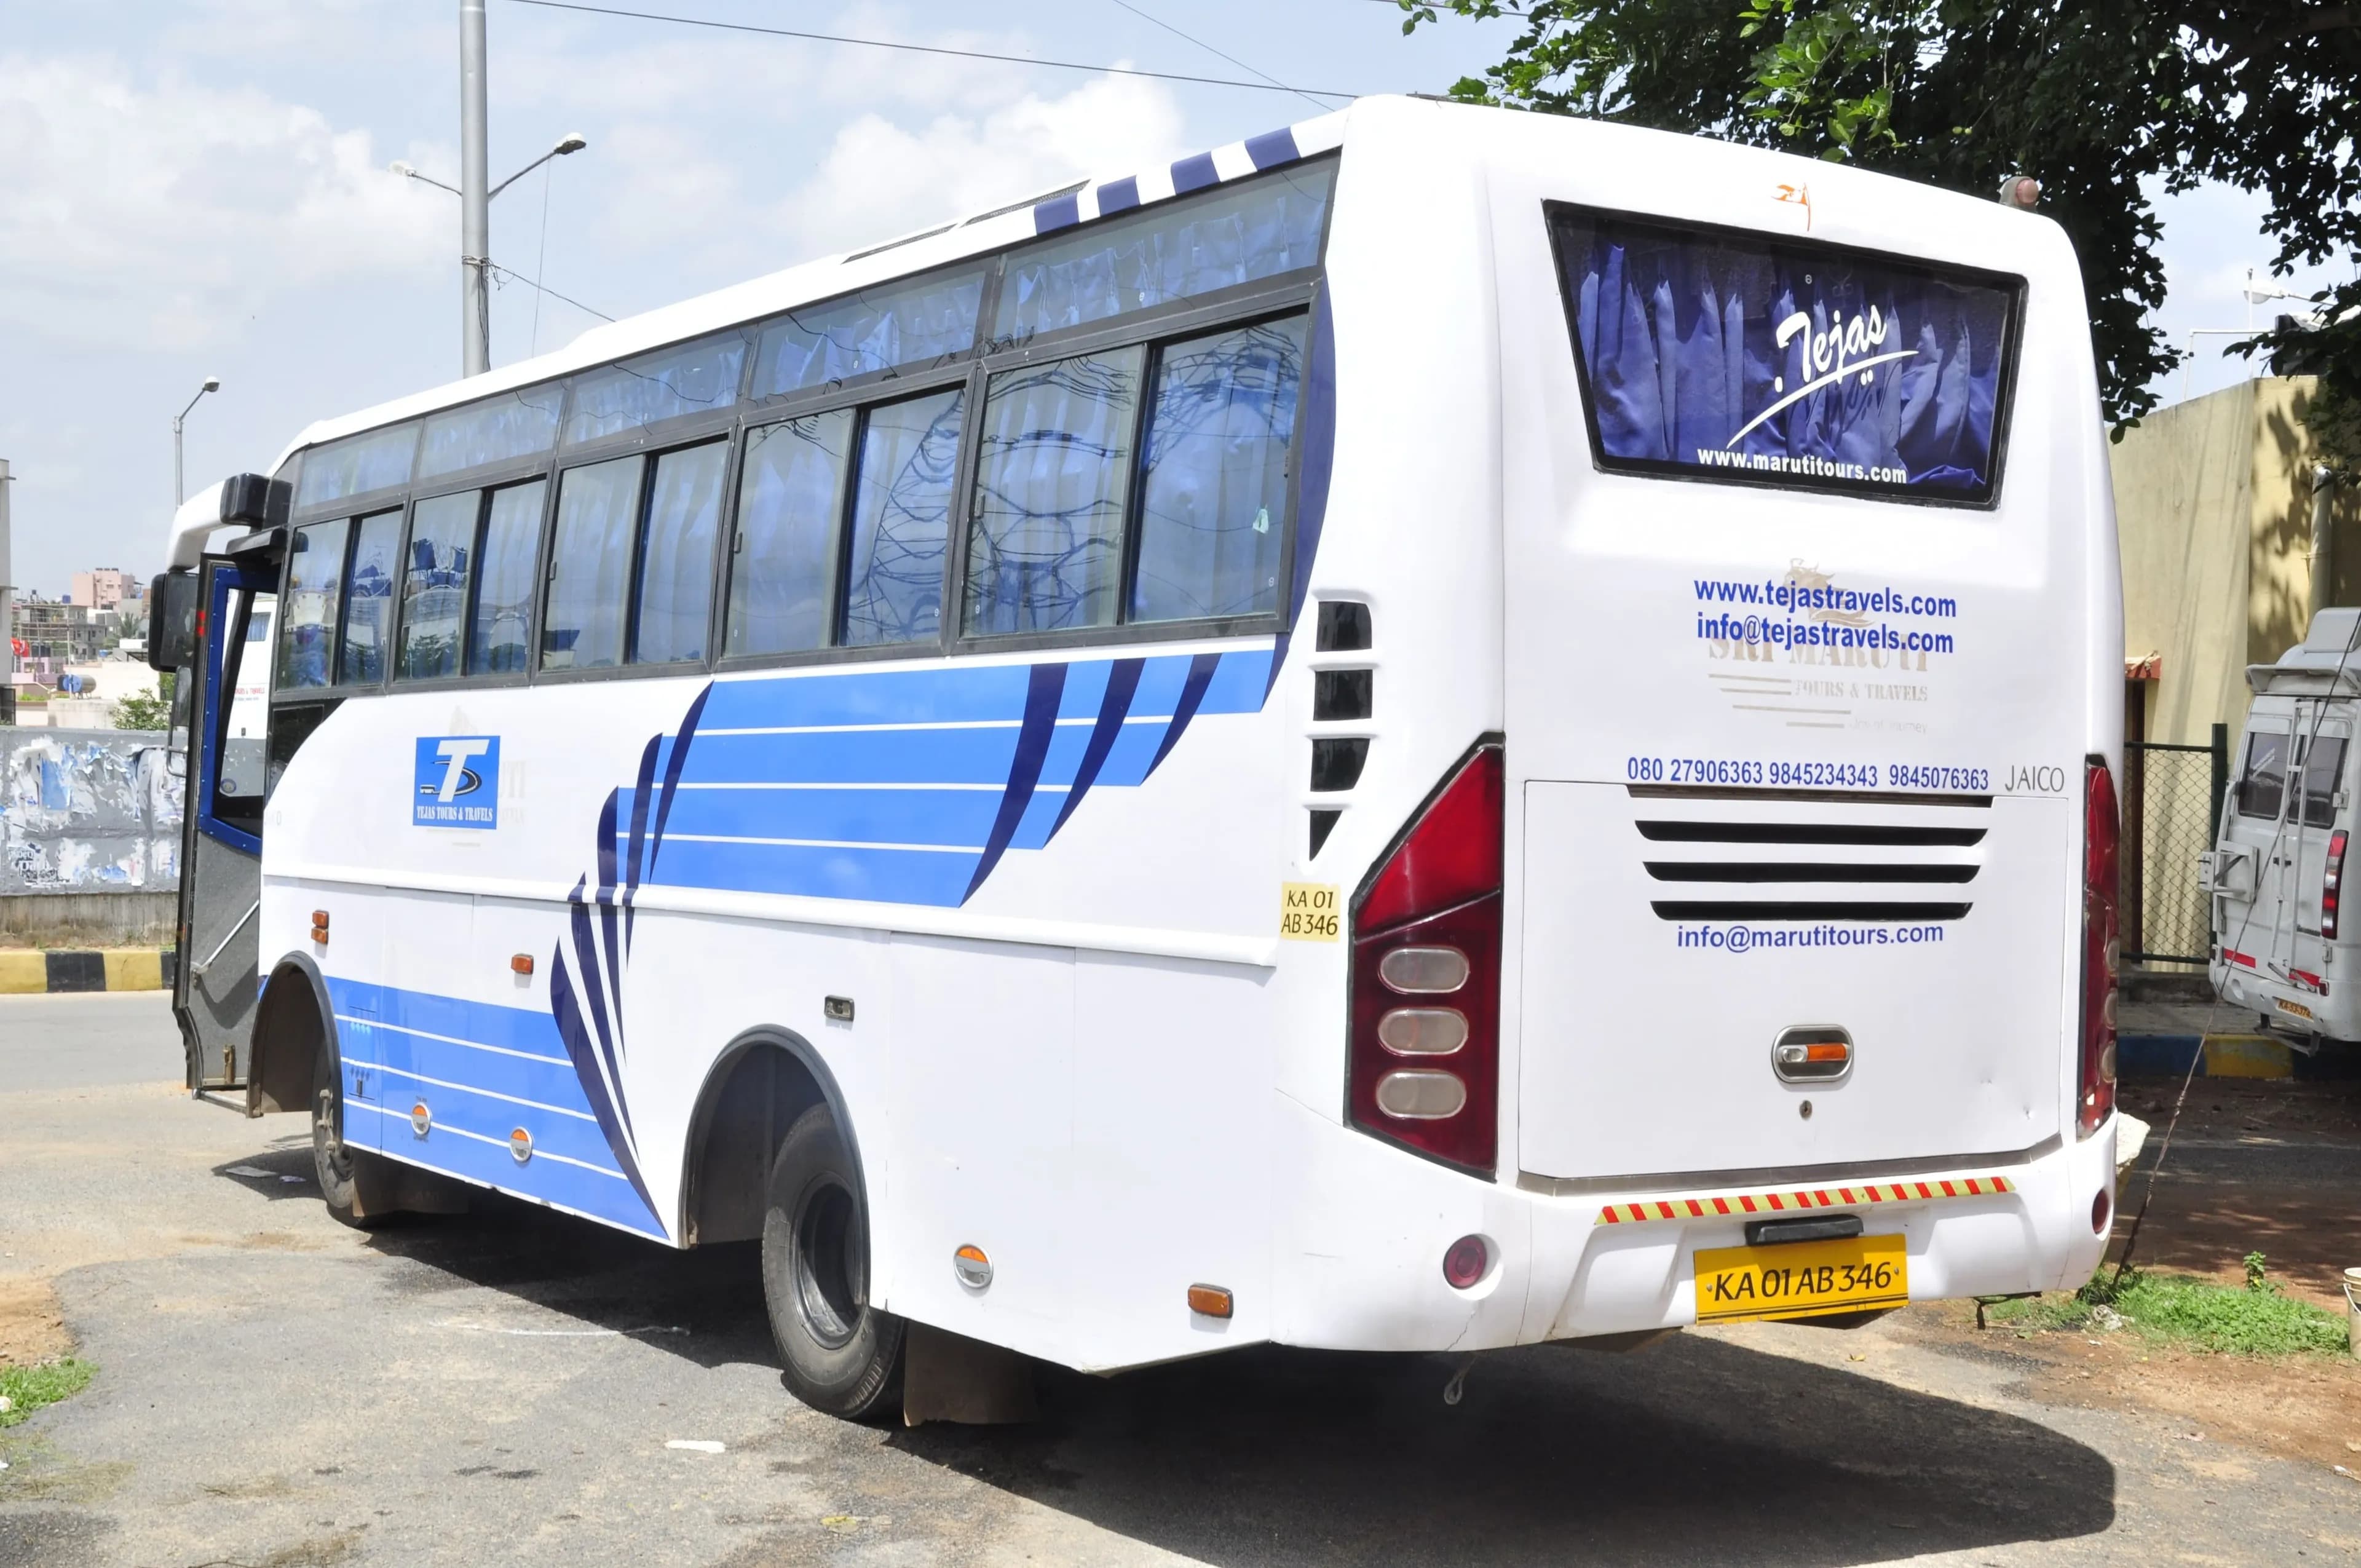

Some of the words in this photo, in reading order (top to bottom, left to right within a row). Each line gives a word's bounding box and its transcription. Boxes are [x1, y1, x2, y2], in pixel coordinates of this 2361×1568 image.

[1776, 305, 1887, 384] Tejas
[1697, 448, 1907, 485] www.marutitours.com
[1694, 580, 1958, 618] www.tejastravels.com
[1697, 611, 1955, 654] info@tejastravels.com
[1795, 678, 1844, 697] TOURS
[1849, 682, 1860, 699] &
[1865, 683, 1928, 702] TRAVELS
[1628, 757, 1664, 782] 080
[1670, 759, 1763, 785] 27906363
[1769, 762, 1878, 788] 9845234343
[1889, 764, 1990, 791] 9845076363
[2004, 765, 2066, 793] JAICO
[417, 806, 435, 820] TEJAS
[437, 806, 457, 821] TOURS
[465, 807, 492, 822] TRAVELS
[1287, 890, 1308, 908] KA
[1313, 890, 1334, 909] 01
[1677, 924, 1944, 953] info@marutitours.com
